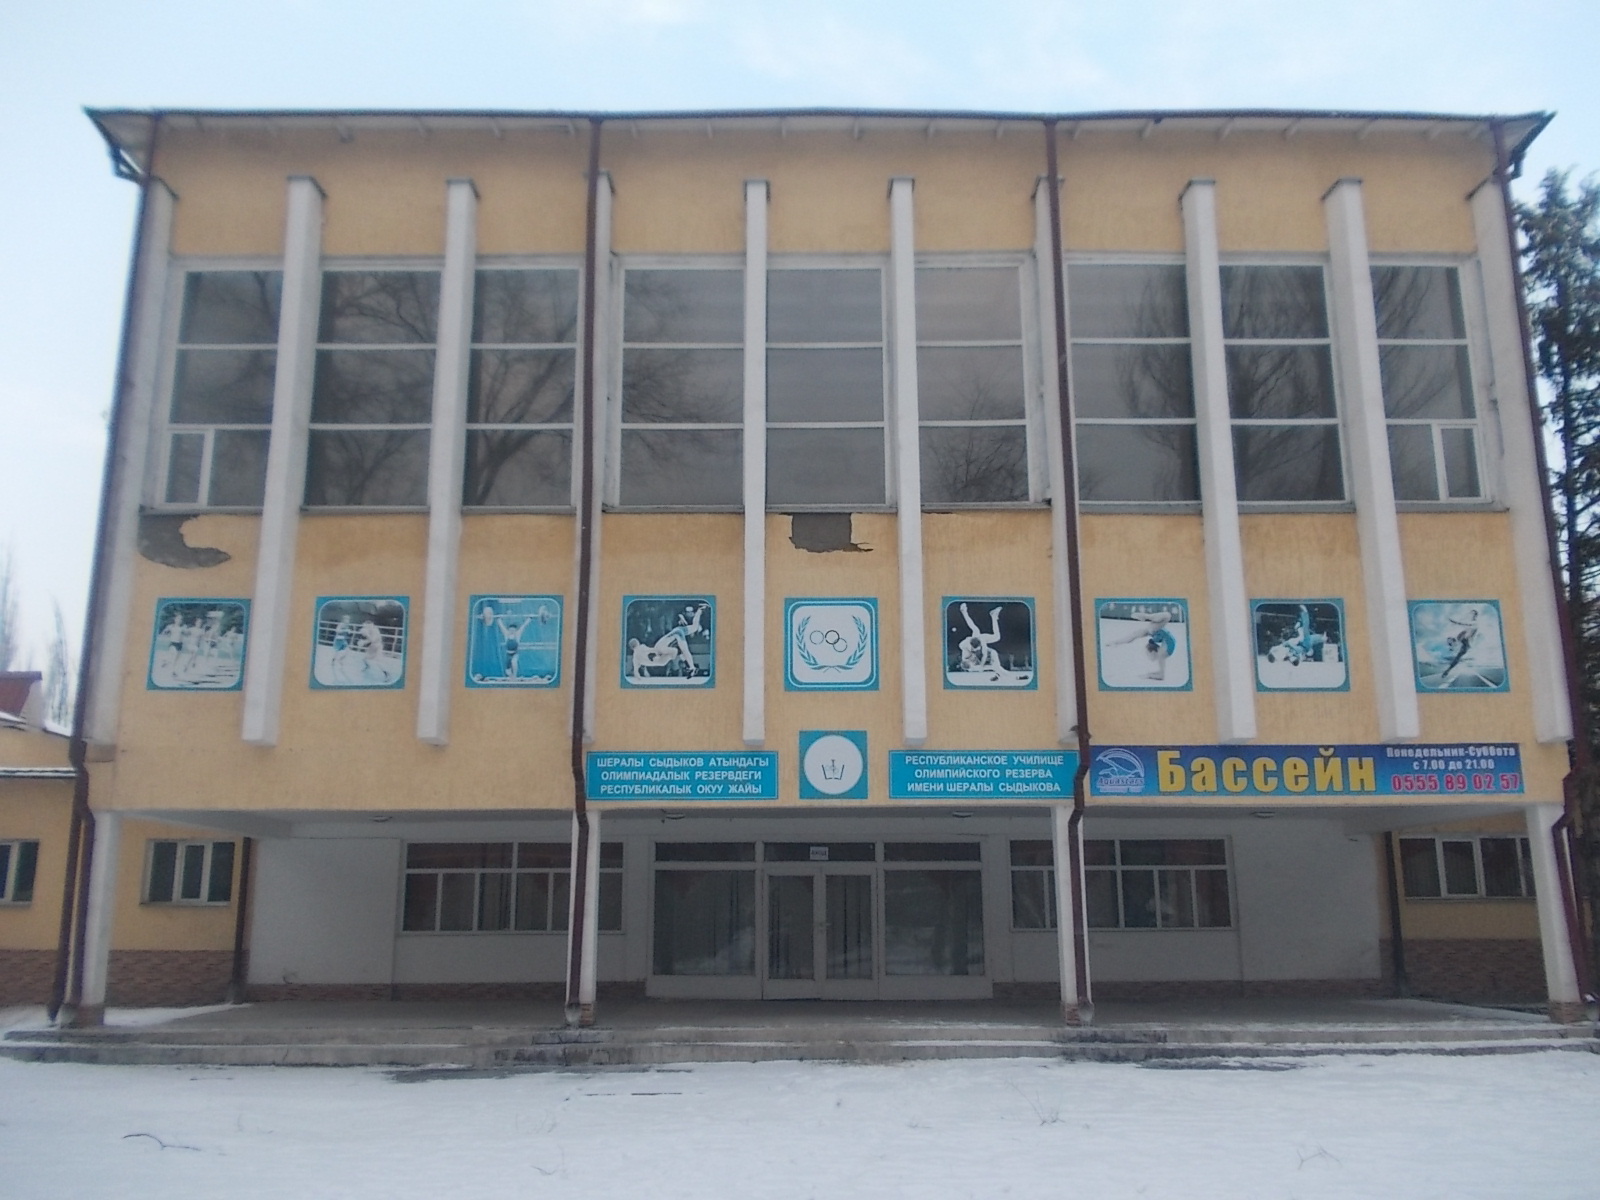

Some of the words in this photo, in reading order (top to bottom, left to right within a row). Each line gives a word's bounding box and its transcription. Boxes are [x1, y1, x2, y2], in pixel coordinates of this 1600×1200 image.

[1387, 746, 1516, 758] Понедельник-Суббота
[596, 757, 644, 768] ШЕРАЛЫ
[648, 757, 704, 769] СЫДЫКОВ
[708, 757, 769, 769] АТЫНДАГЫ
[905, 755, 1008, 766] РЕСПУБЛИКАНСКОЕ
[1013, 755, 1064, 767] УЧИЛИЩЕ
[1422, 759, 1445, 770] 7.00
[1448, 760, 1463, 771] до
[1465, 759, 1496, 770] 21.00
[600, 770, 690, 782] ОЛИМПИАДАЛЫК
[694, 770, 762, 782] РЕЗЕРВДЕГИ
[914, 768, 1001, 779] ОЛИМПИЙСКОГО
[1005, 769, 1053, 779] РЕЗЕРВА
[1157, 747, 1376, 793] Бассейн
[907, 782, 944, 792] ИМЕНИ
[946, 782, 994, 792] ШЕРАЛЫ
[998, 782, 1062, 794] СЫДЫКОВА
[1391, 774, 1440, 792] 0555
[1444, 774, 1467, 792] 89
[1472, 774, 1494, 791] 02
[1499, 773, 1520, 791] 57
[600, 784, 692, 795] РЕСПУБЛИКАЛЫК
[696, 784, 724, 794] ОКУУ
[728, 783, 762, 794] ЖАЙЫ
